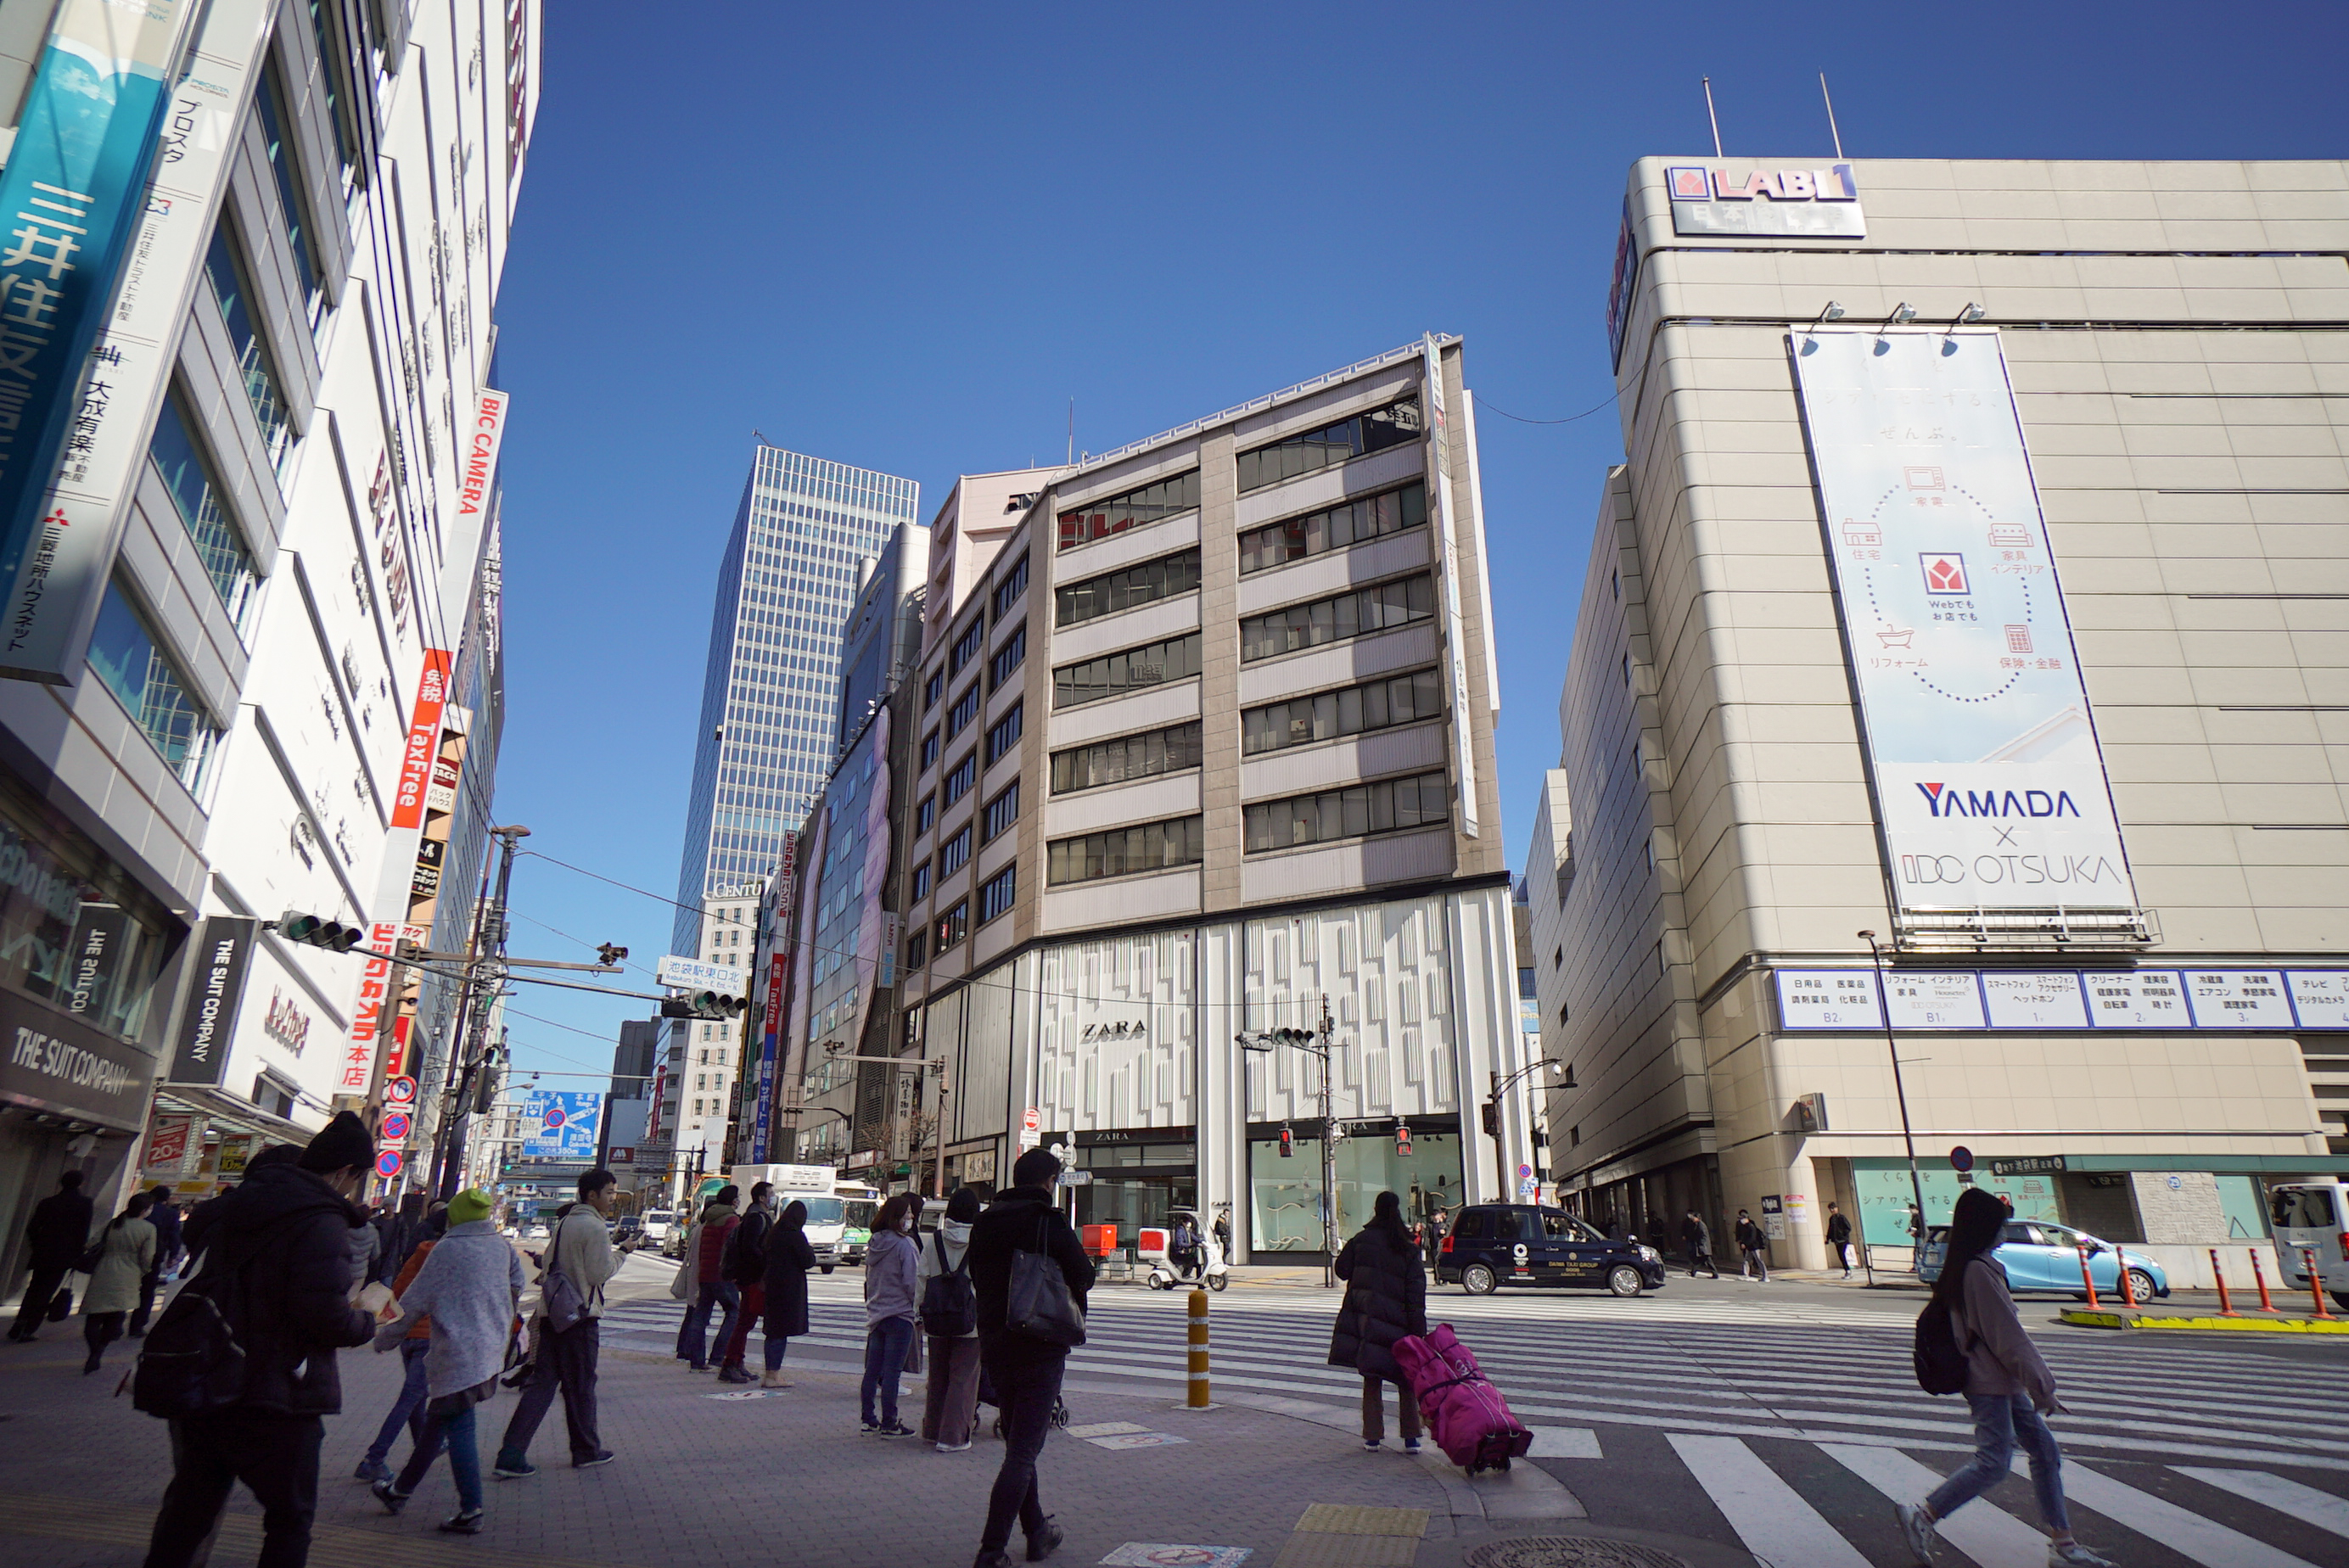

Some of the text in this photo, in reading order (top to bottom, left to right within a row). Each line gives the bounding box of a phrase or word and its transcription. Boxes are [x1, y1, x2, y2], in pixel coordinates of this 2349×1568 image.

[163, 99, 202, 163] プロスタ
[458, 396, 501, 515] BIC CAMERA
[1852, 549, 1881, 562] 住宅
[1990, 563, 2045, 575] インテリア
[1870, 656, 1929, 669] リフォーム
[421, 668, 446, 704] 免税
[1915, 781, 2081, 818] YAMADA
[1973, 854, 2122, 884] OTSUKA
[668, 960, 740, 983] 池袋駅東口北
[1794, 979, 1865, 988] 日用品 医薬品
[1885, 976, 1971, 984] リフォーム インテリア
[1987, 980, 2032, 988] スマートフォン
[2090, 976, 2132, 984] クリーナー
[2198, 976, 2269, 984] 冷蔵庫 洗濯機
[2302, 980, 2329, 988] テレビ
[1897, 988, 1918, 997] 家具
[2097, 988, 2177, 996] 健康家電 照明器具
[190, 938, 235, 1062] THE SUIT COMPANY
[1791, 995, 1868, 1004] 調剤薬局 化粧品
[2103, 1000, 2129, 1009] 自転車
[2296, 995, 2346, 1005] デジタルカメラ
[2223, 1000, 2259, 1010] 調理家電
[1084, 1019, 1147, 1038] ZARA
[11, 1027, 132, 1097] THE SUIT COMPANY
[1096, 1133, 1130, 1141] ZARA
